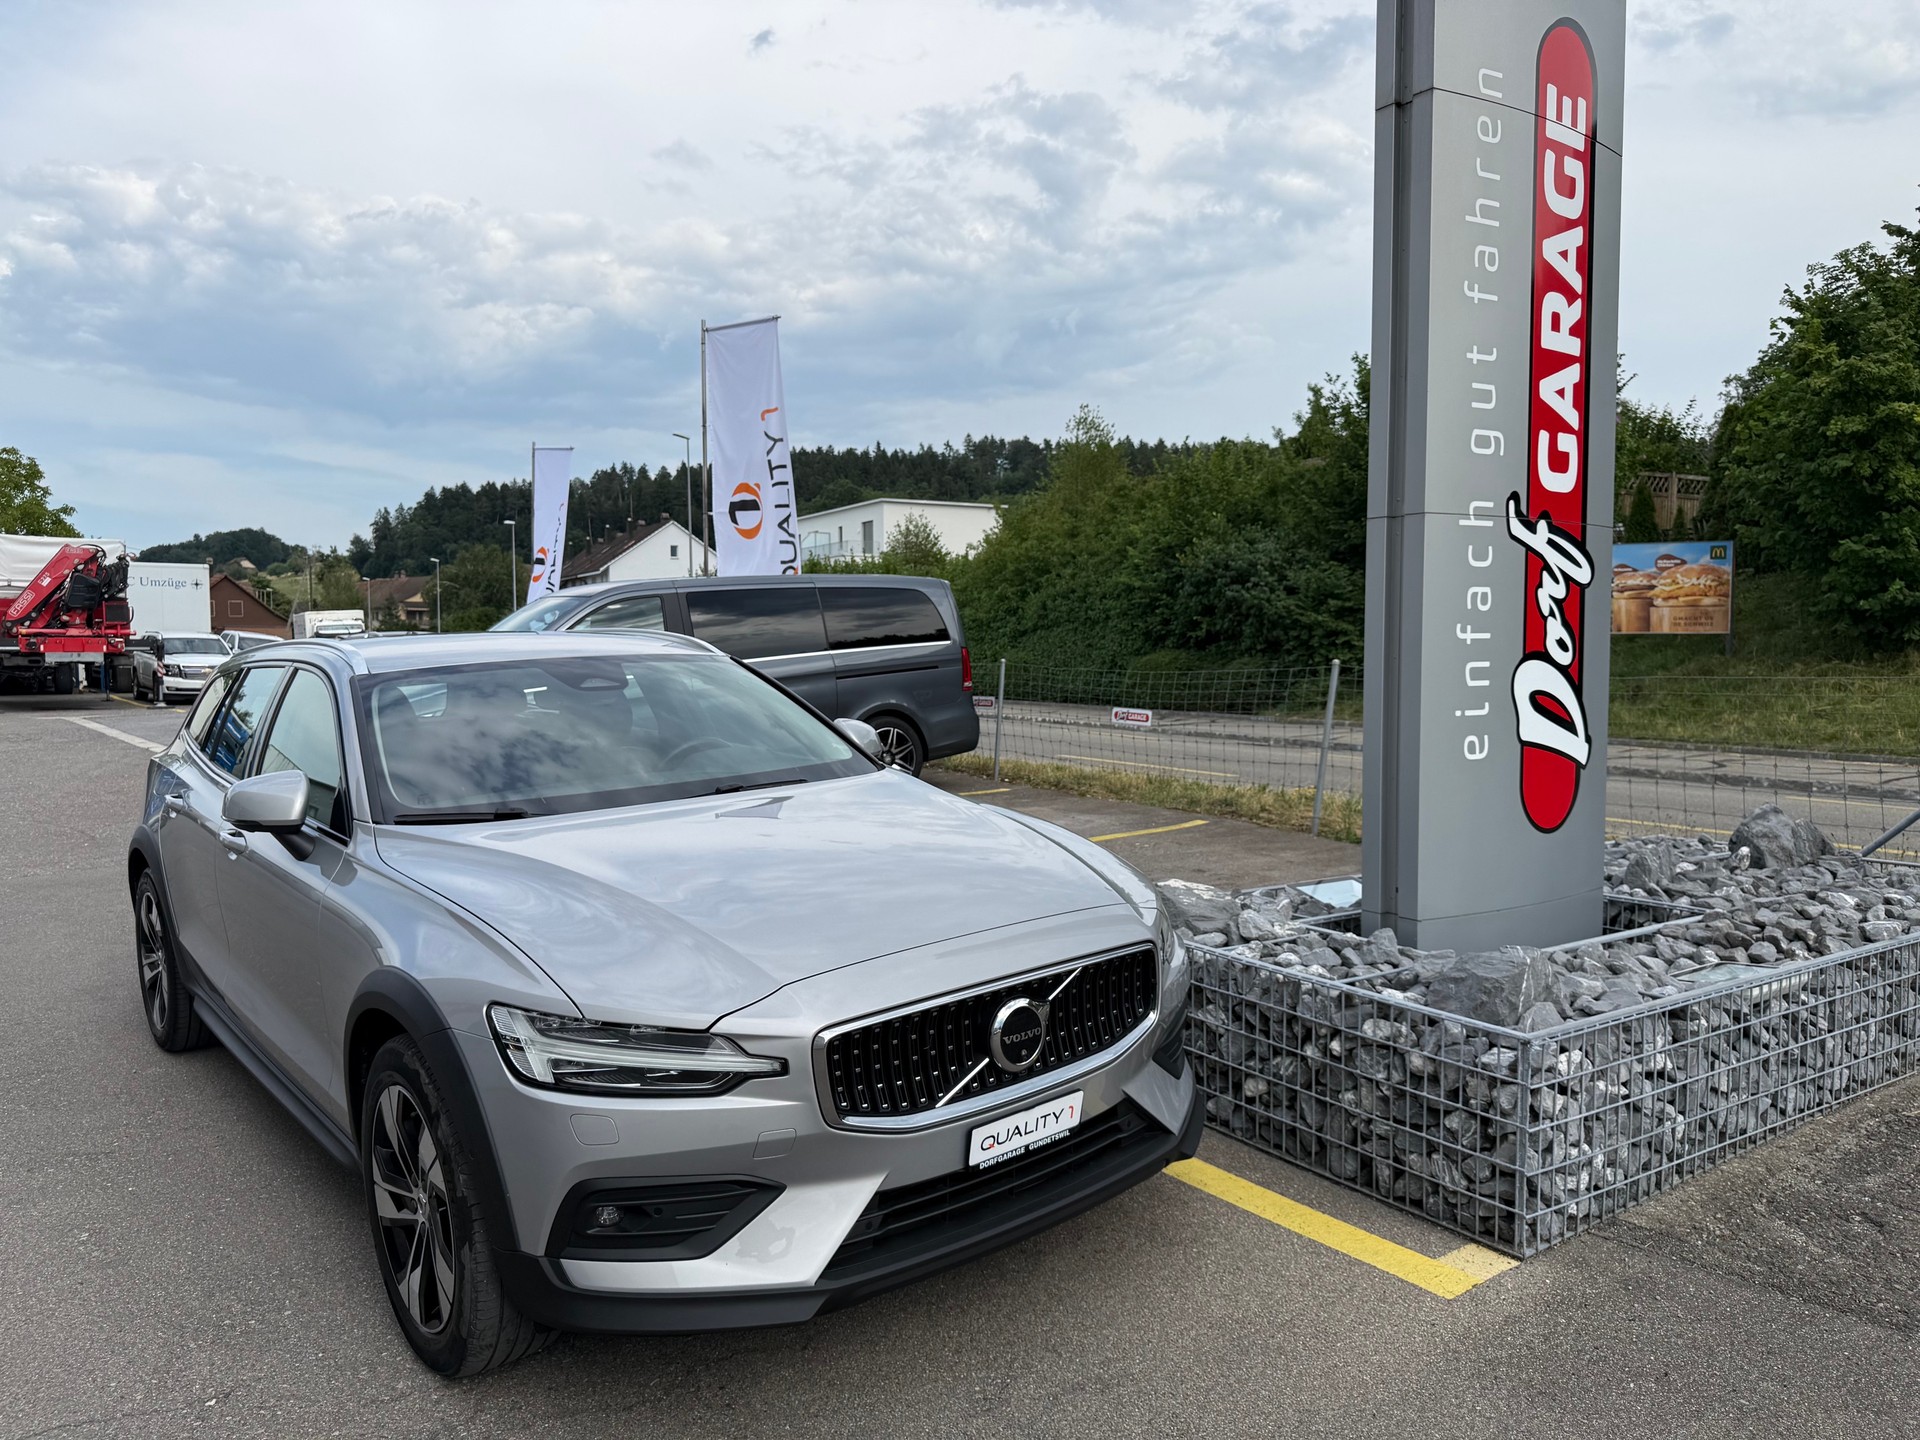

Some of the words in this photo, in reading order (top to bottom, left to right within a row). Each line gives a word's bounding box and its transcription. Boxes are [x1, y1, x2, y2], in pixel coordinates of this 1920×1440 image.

[1463, 67, 1504, 303] fahren
[1537, 83, 1587, 493] GARAGE
[1466, 345, 1504, 456] gut
[10, 591, 34, 616] FASSI
[140, 576, 187, 589] Umzüge
[1455, 500, 1494, 760] einfach
[1507, 495, 1593, 768] Dorf
[1002, 1027, 1041, 1044] VOLVO
[980, 1108, 1064, 1151] QUALITY
[980, 1146, 1026, 1170] DORFGARAGE
[1028, 1129, 1071, 1151] GUNDETSWIL
